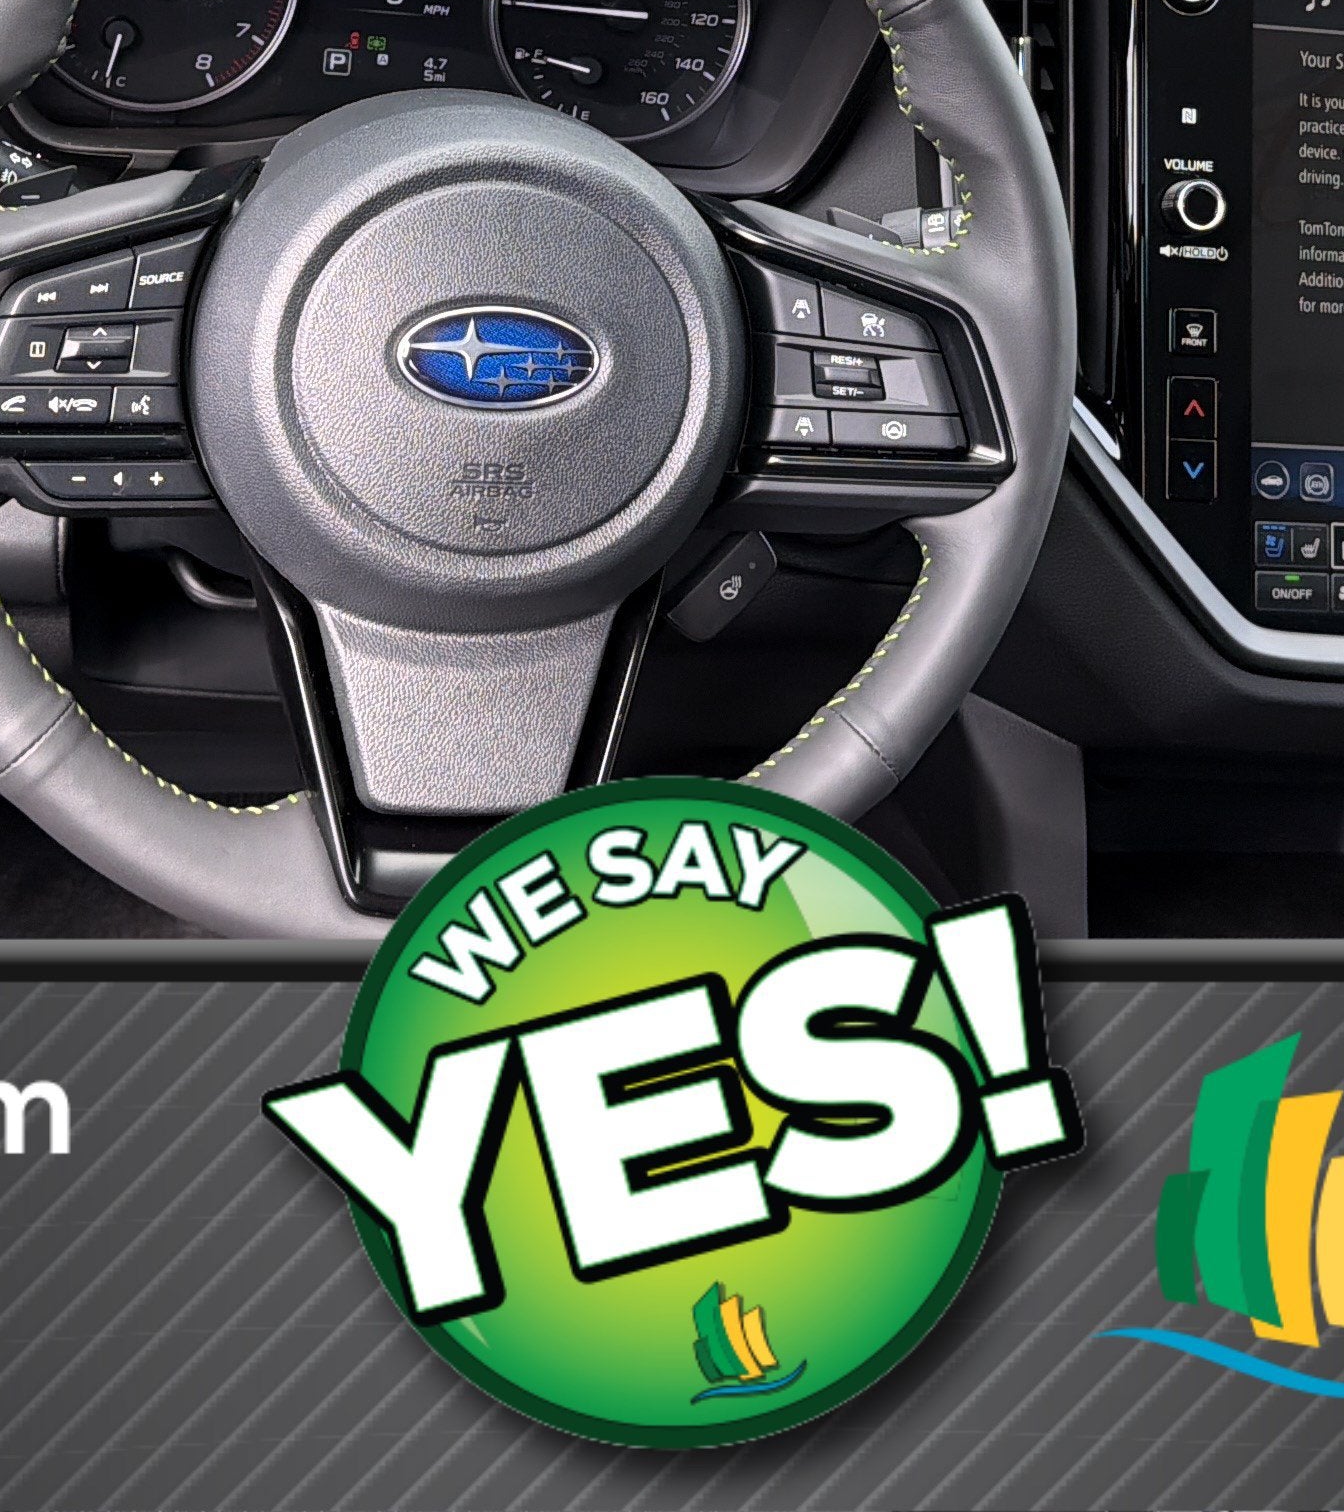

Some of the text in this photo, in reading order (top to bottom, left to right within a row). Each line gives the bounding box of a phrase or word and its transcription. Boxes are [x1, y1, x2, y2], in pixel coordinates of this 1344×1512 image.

[423, 4, 450, 16] MPH
[690, 13, 719, 26] 120
[236, 23, 251, 37] 7
[195, 54, 212, 70] 8
[329, 53, 346, 70] P
[423, 57, 447, 70] 4.7
[675, 58, 704, 71] 140
[1300, 50, 1331, 69] Your
[115, 76, 127, 87] C
[423, 70, 446, 82] 5mi
[641, 91, 669, 105] 160
[1299, 93, 1308, 107] It
[1311, 94, 1321, 108] is
[581, 110, 590, 121] E
[1299, 143, 1340, 160] device.
[1164, 158, 1214, 172] VOLUME
[1299, 169, 1344, 189] driving.
[1184, 247, 1216, 259] HOLD
[139, 271, 184, 286] SOURCE
[1299, 297, 1316, 313] for
[1181, 337, 1208, 347] FRONT
[462, 463, 525, 480] SRS
[1272, 588, 1313, 601] ON/OFF
